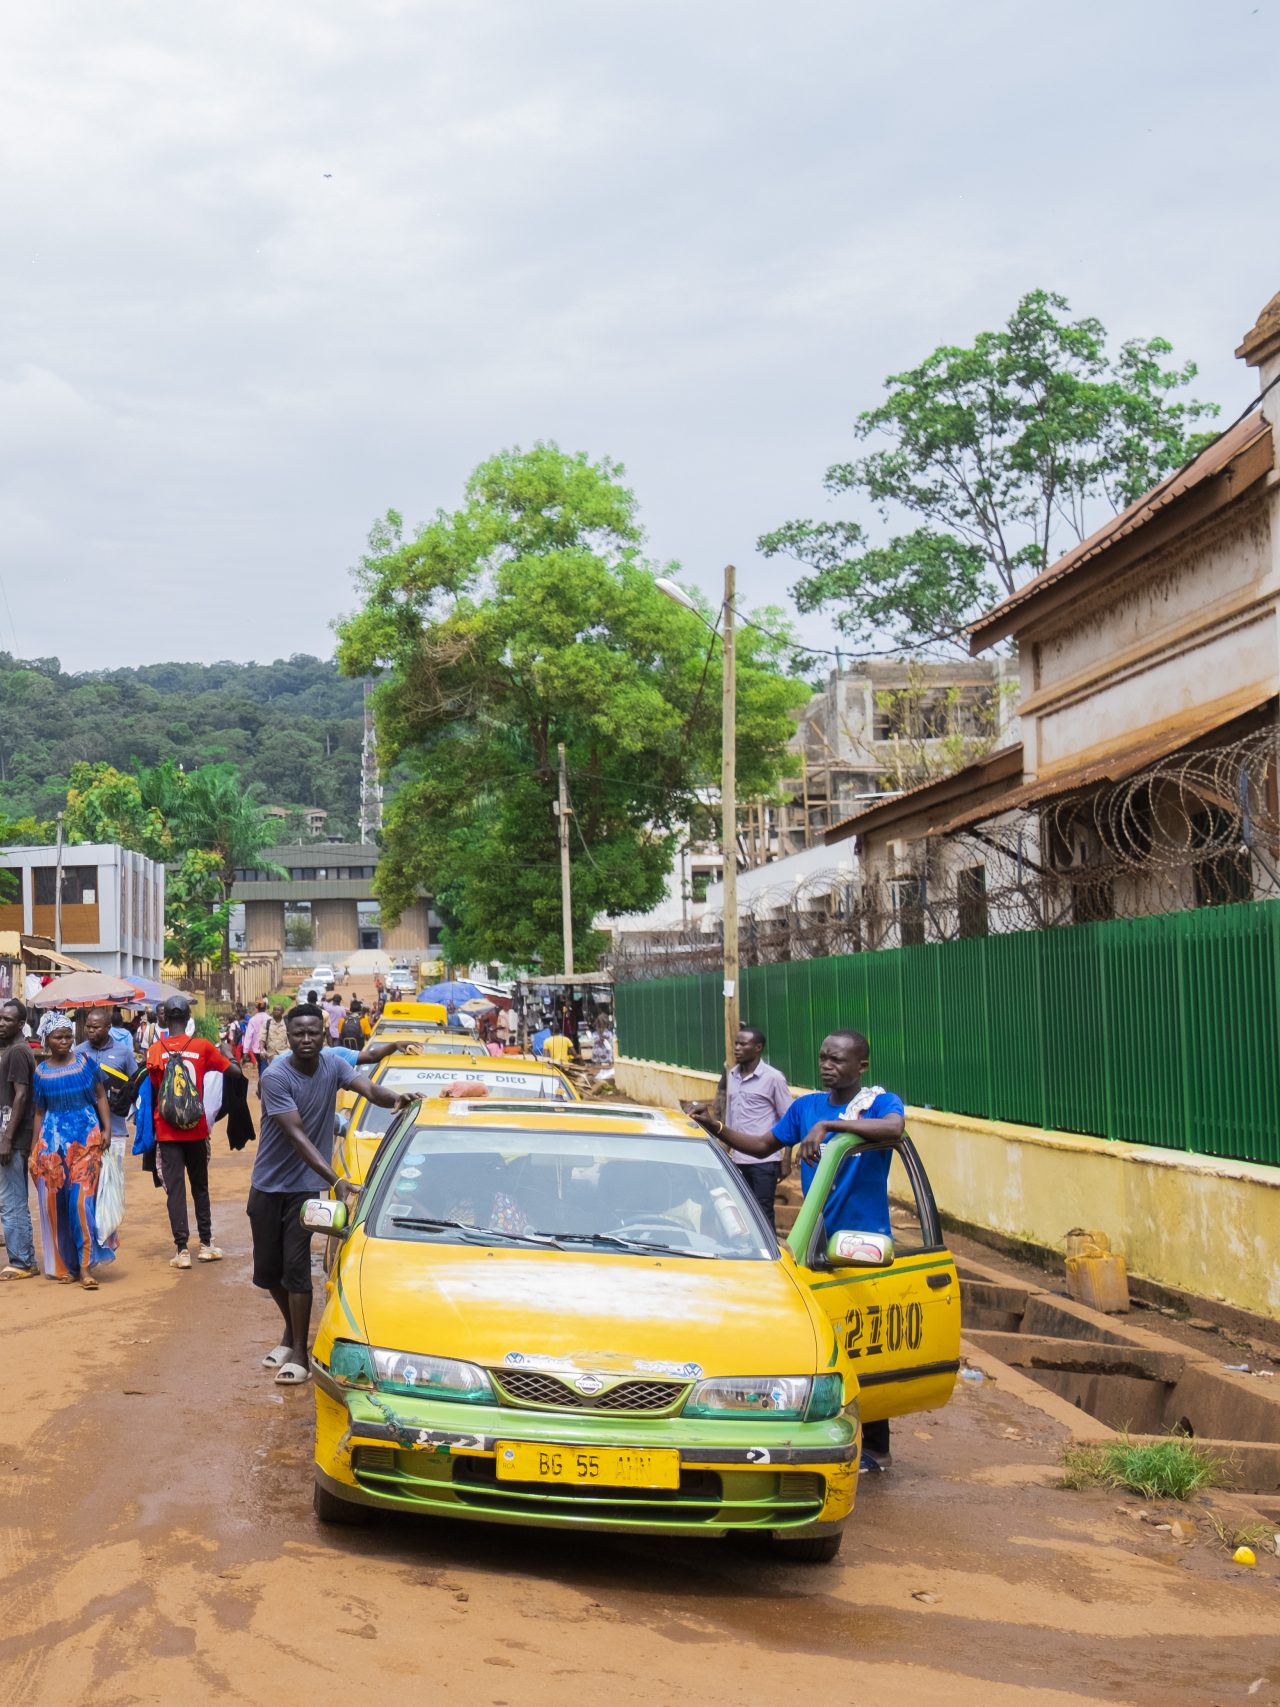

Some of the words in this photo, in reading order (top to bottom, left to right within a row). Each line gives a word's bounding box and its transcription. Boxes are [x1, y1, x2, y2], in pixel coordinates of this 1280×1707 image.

[416, 1072, 458, 1080] GRACE
[465, 1073, 485, 1081] DE
[495, 1075, 527, 1084] DIEU
[539, 1452, 563, 1476] BG
[576, 1454, 600, 1478] 55
